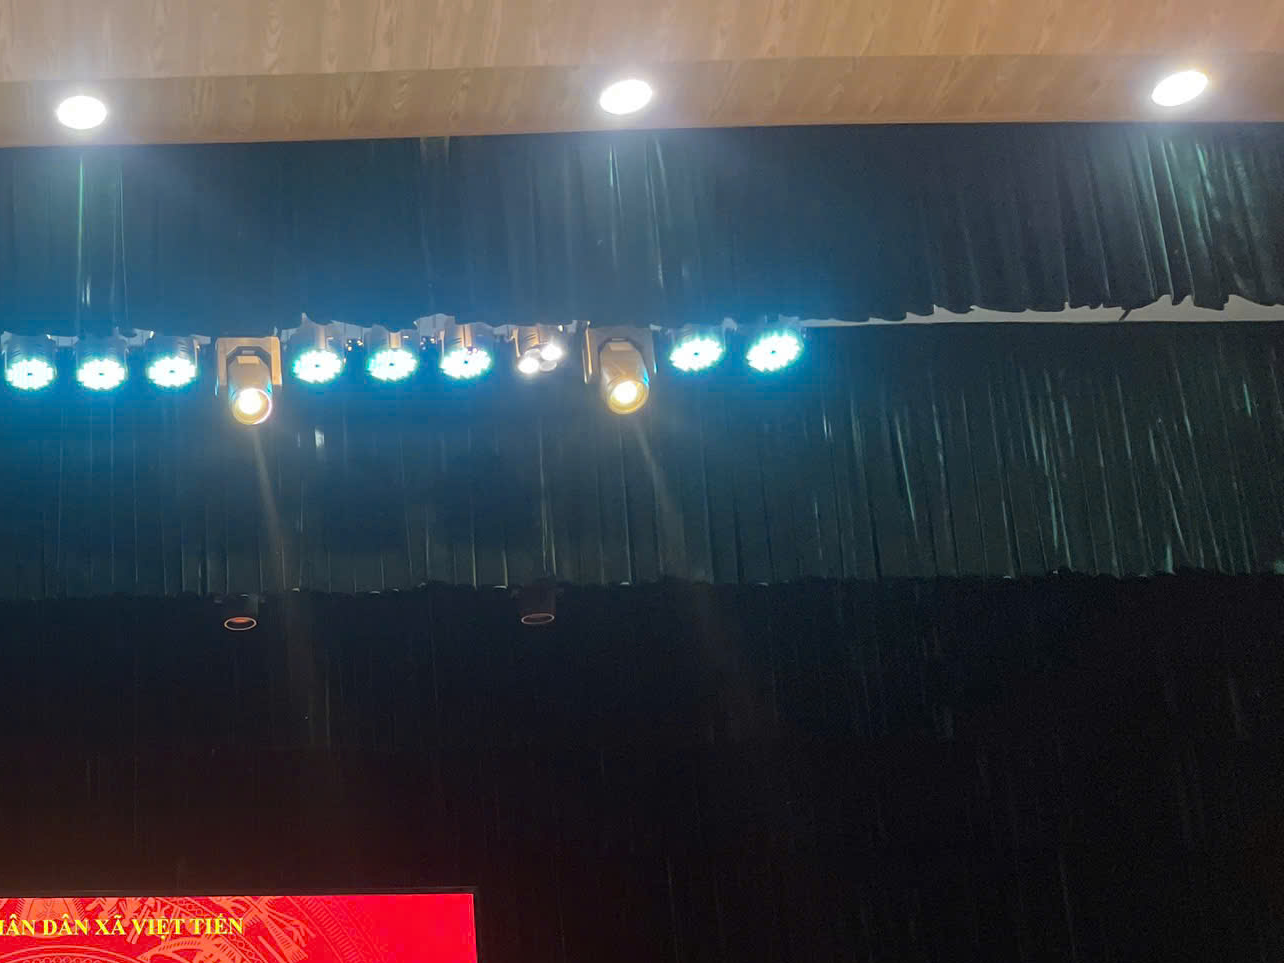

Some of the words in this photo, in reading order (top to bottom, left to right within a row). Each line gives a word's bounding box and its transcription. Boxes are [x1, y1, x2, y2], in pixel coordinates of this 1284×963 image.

[43, 913, 89, 936] DÂN
[95, 913, 125, 936] XÃ
[131, 914, 186, 939] VIỆT
[189, 912, 244, 935] TIẾN
